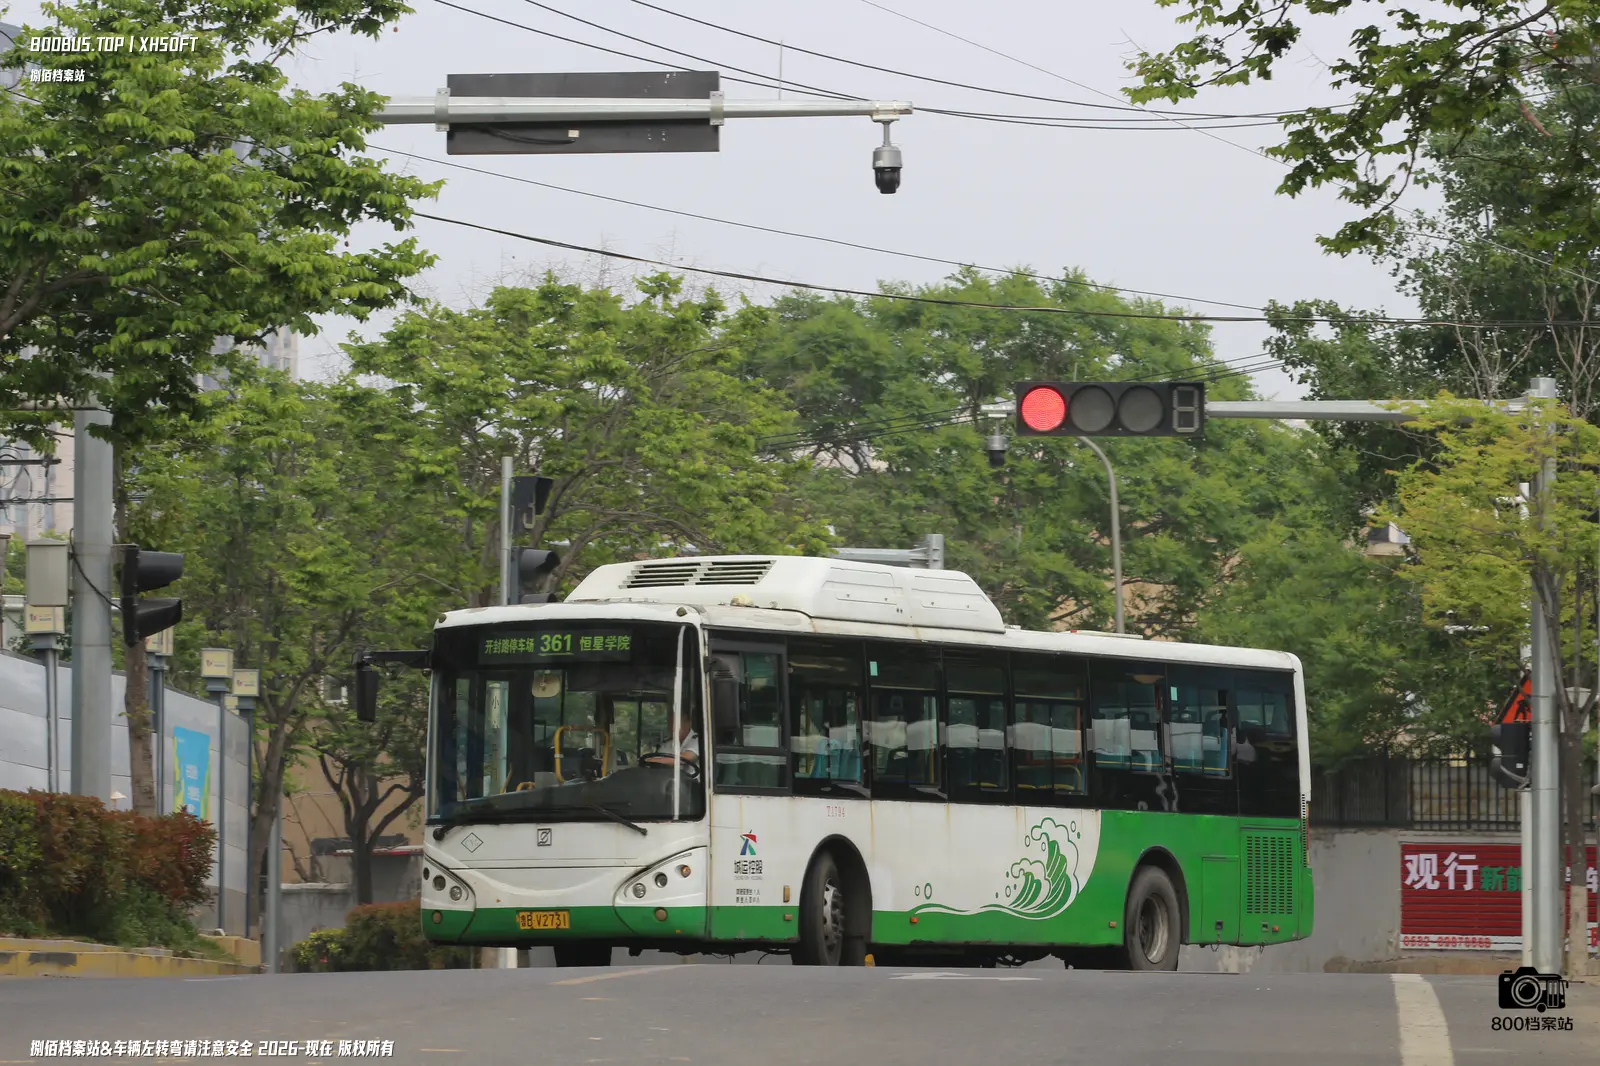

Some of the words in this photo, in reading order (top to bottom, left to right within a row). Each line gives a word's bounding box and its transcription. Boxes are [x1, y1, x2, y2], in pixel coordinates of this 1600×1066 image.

[540, 634, 572, 652] 361
[580, 635, 631, 652] 恒星学院
[1404, 852, 1479, 890] 观行
